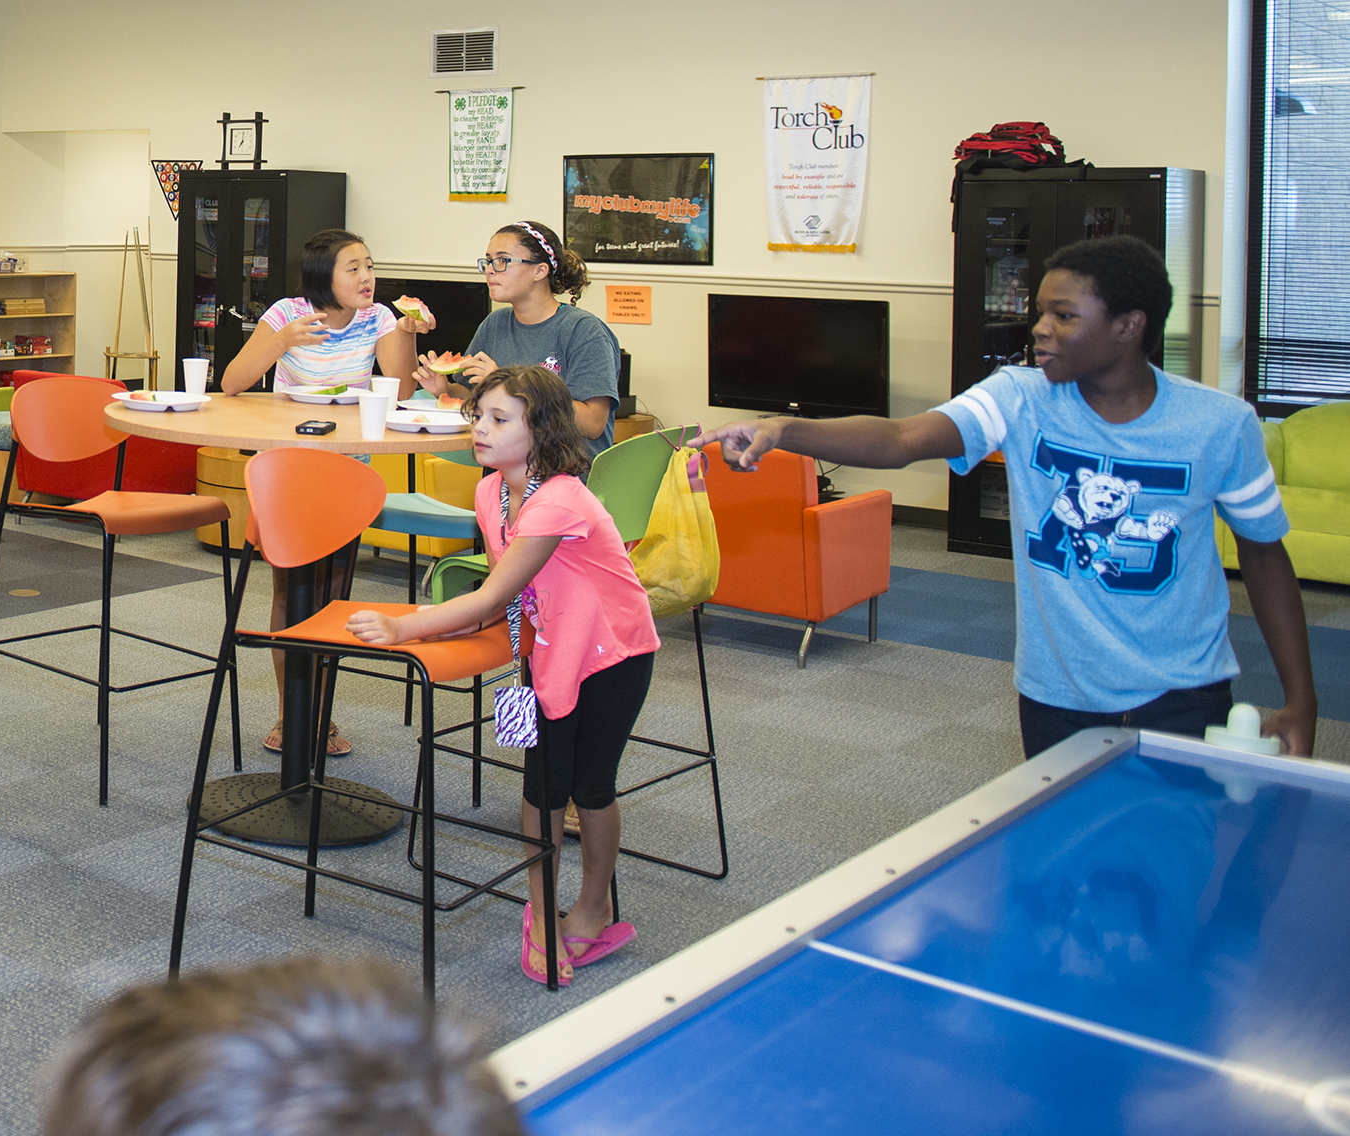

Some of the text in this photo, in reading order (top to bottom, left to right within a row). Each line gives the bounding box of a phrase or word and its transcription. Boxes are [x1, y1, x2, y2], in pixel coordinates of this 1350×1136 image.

[468, 95, 497, 107] I PLEDGE
[477, 107, 494, 115] HEAD
[770, 102, 830, 129] Torch
[812, 124, 865, 150] Club
[574, 194, 701, 221] myclubmylife
[595, 242, 605, 253] for
[622, 241, 637, 250] with
[638, 241, 654, 252] great
